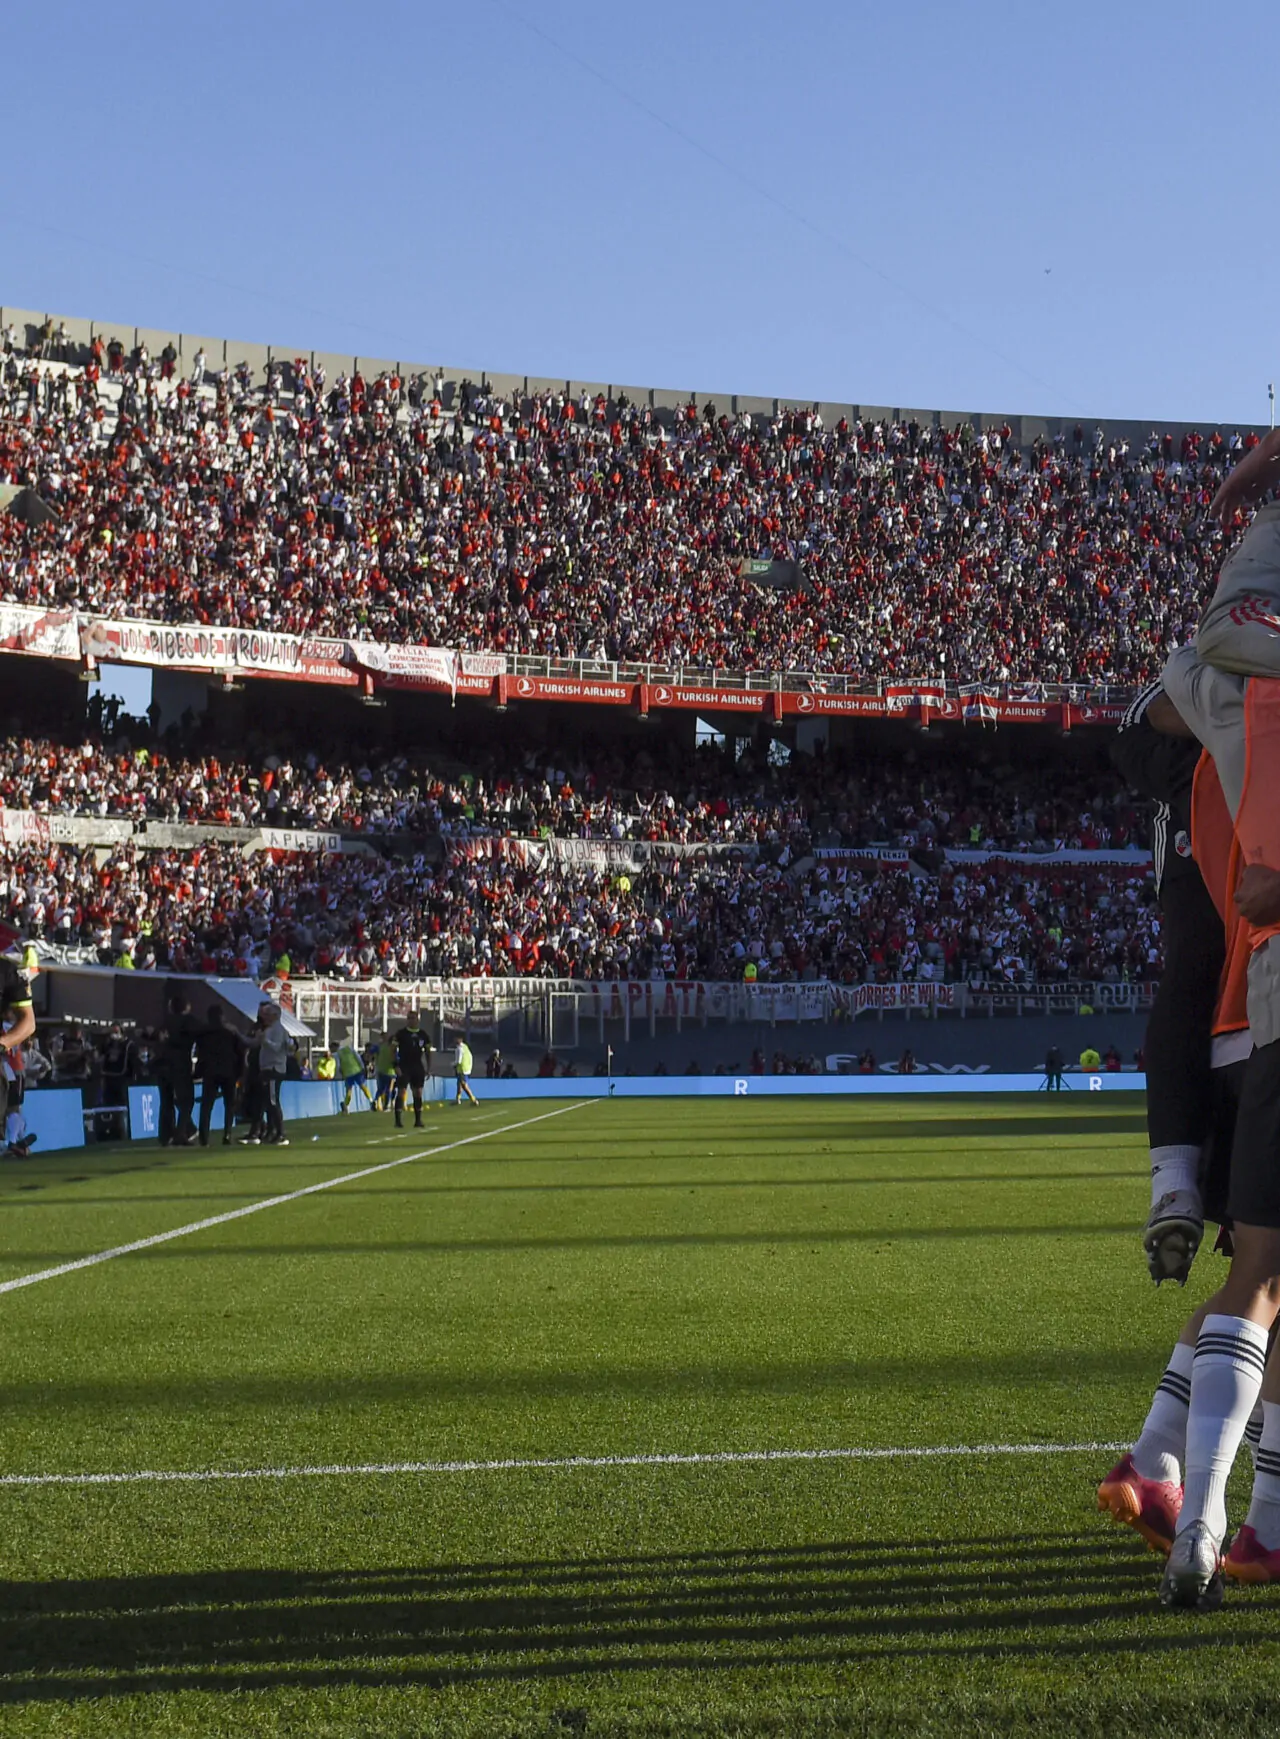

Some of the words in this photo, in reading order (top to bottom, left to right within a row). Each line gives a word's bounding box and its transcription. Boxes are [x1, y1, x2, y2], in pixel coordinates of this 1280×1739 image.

[309, 665, 352, 678] AIRLINES
[538, 683, 582, 695] TURKISH
[583, 686, 626, 698] AIRLINES
[676, 692, 719, 703] TURKISH
[720, 695, 763, 706] AIRLINES
[818, 700, 859, 710] TURKISH
[1004, 707, 1047, 717] AIRLINES
[734, 1079, 748, 1094] R
[1089, 1076, 1102, 1091] R
